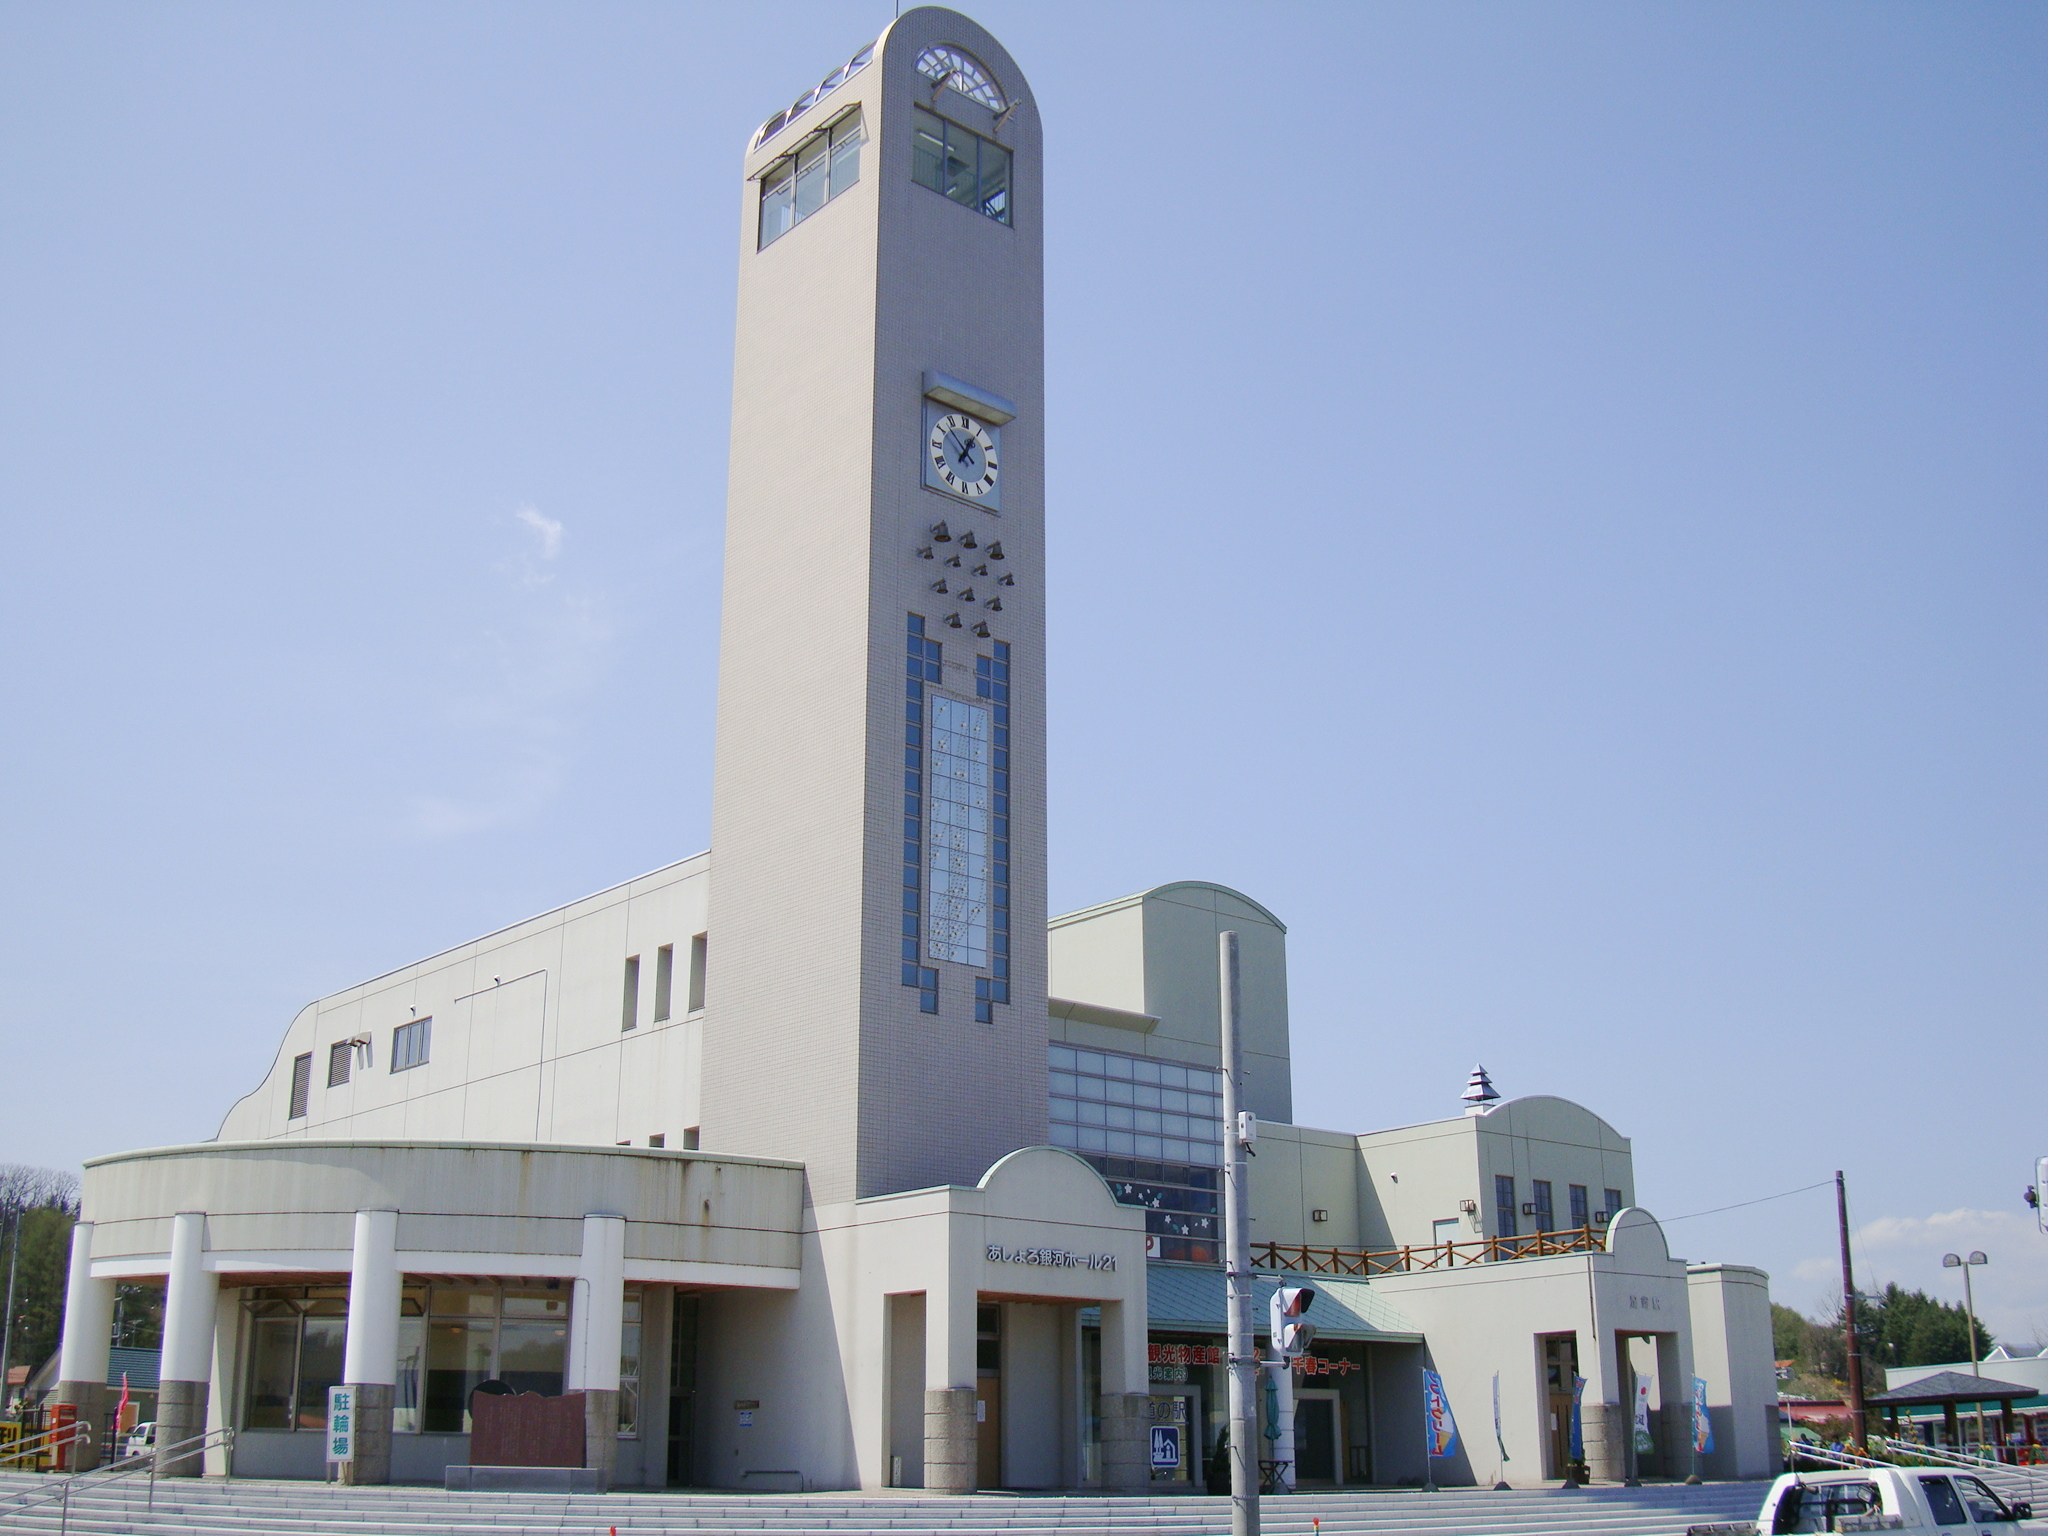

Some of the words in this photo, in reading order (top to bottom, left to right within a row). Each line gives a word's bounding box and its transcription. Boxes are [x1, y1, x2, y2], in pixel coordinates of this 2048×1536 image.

[987, 1244, 1119, 1272] あしょろ銀河ホール21
[1148, 1343, 1220, 1365] 観光物産館
[332, 1393, 350, 1455] 駐輪場
